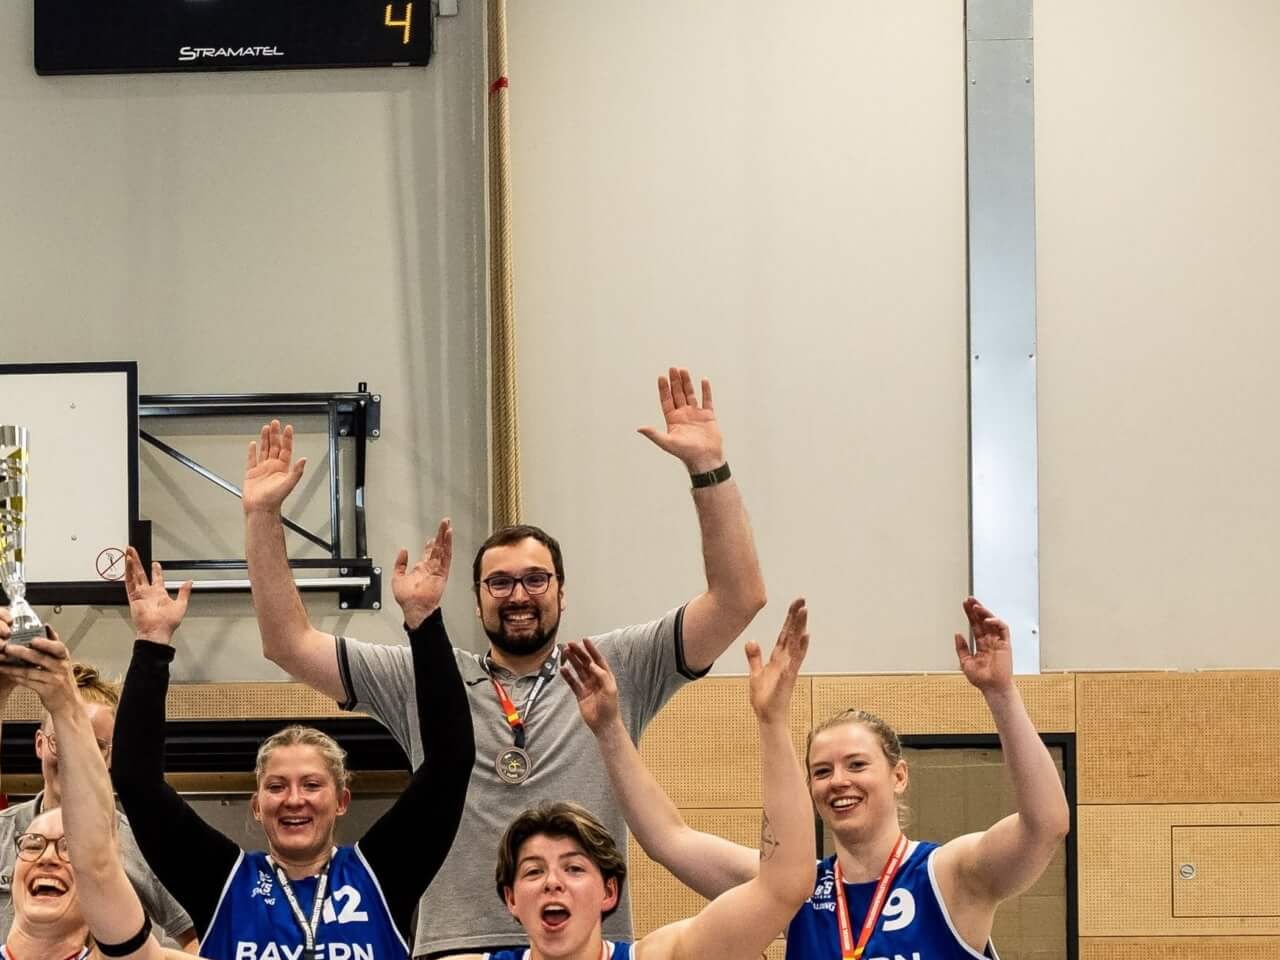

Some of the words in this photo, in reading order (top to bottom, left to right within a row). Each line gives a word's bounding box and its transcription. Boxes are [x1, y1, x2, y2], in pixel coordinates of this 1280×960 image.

[384, 3, 413, 44] 4
[178, 46, 284, 61] STRAMATEL
[881, 888, 915, 931] 9
